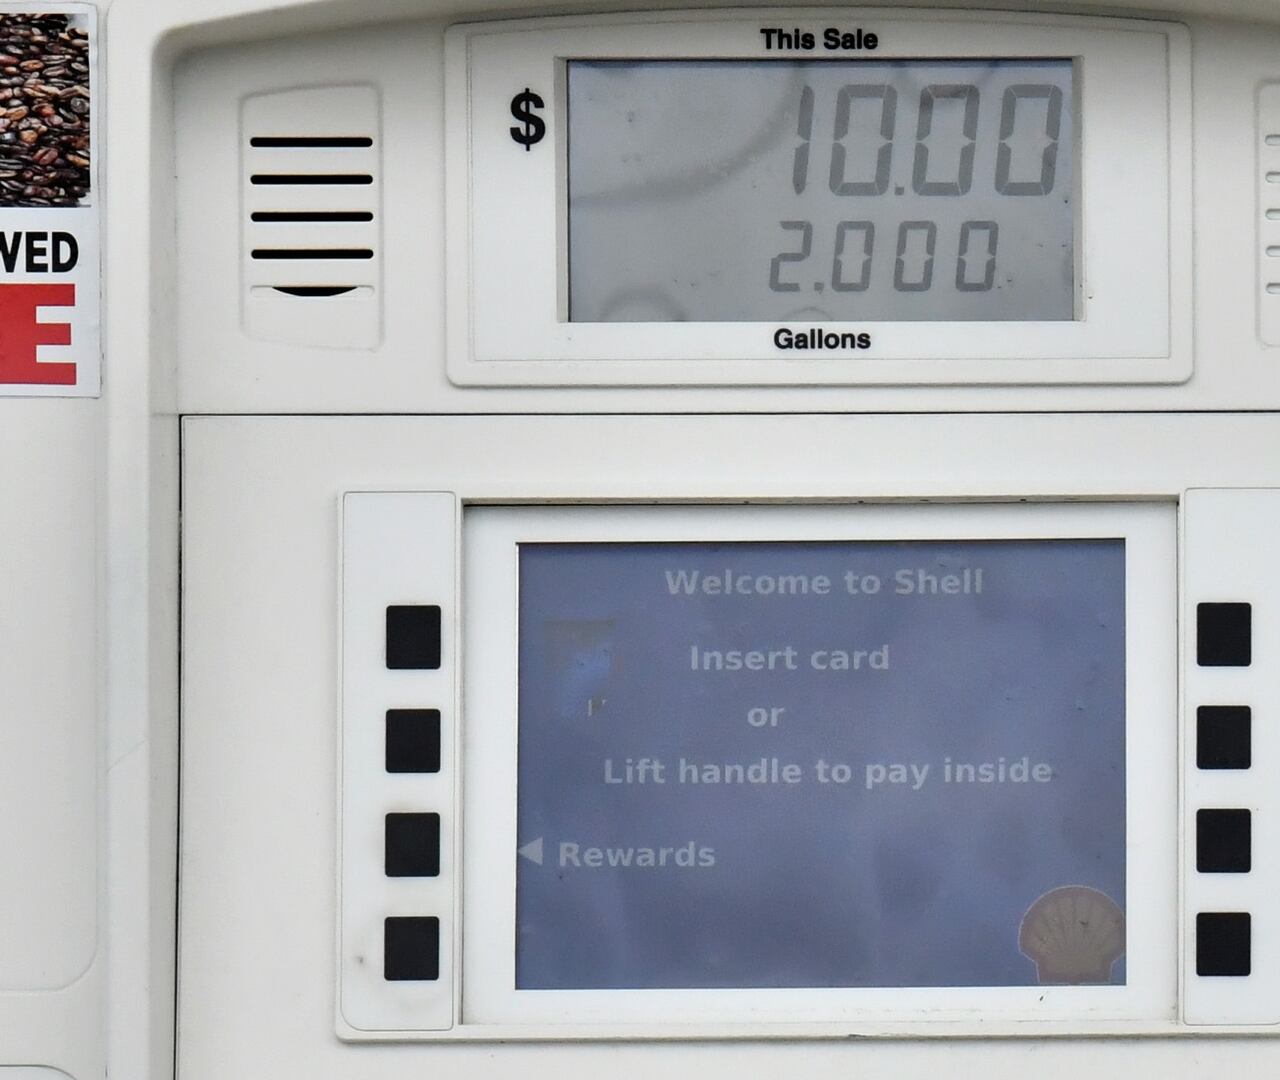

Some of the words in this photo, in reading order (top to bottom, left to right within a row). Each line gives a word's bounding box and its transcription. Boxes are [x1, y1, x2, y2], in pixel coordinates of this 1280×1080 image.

[760, 28, 815, 50] This
[824, 28, 878, 50] Sale
[510, 87, 546, 151] $
[792, 83, 1063, 197] 10.00
[768, 220, 999, 293] 2.000
[774, 328, 871, 349] Gallons
[665, 569, 831, 595] Welcome
[844, 571, 880, 594] to
[896, 567, 983, 595] Shell
[691, 646, 797, 670] Insert
[811, 645, 889, 670] card
[748, 708, 784, 726] or
[603, 758, 664, 784] Lift
[680, 758, 801, 783] handle
[815, 759, 851, 783] to
[866, 764, 930, 790] pay
[944, 757, 1052, 782] inside
[560, 841, 715, 867] Rewards
